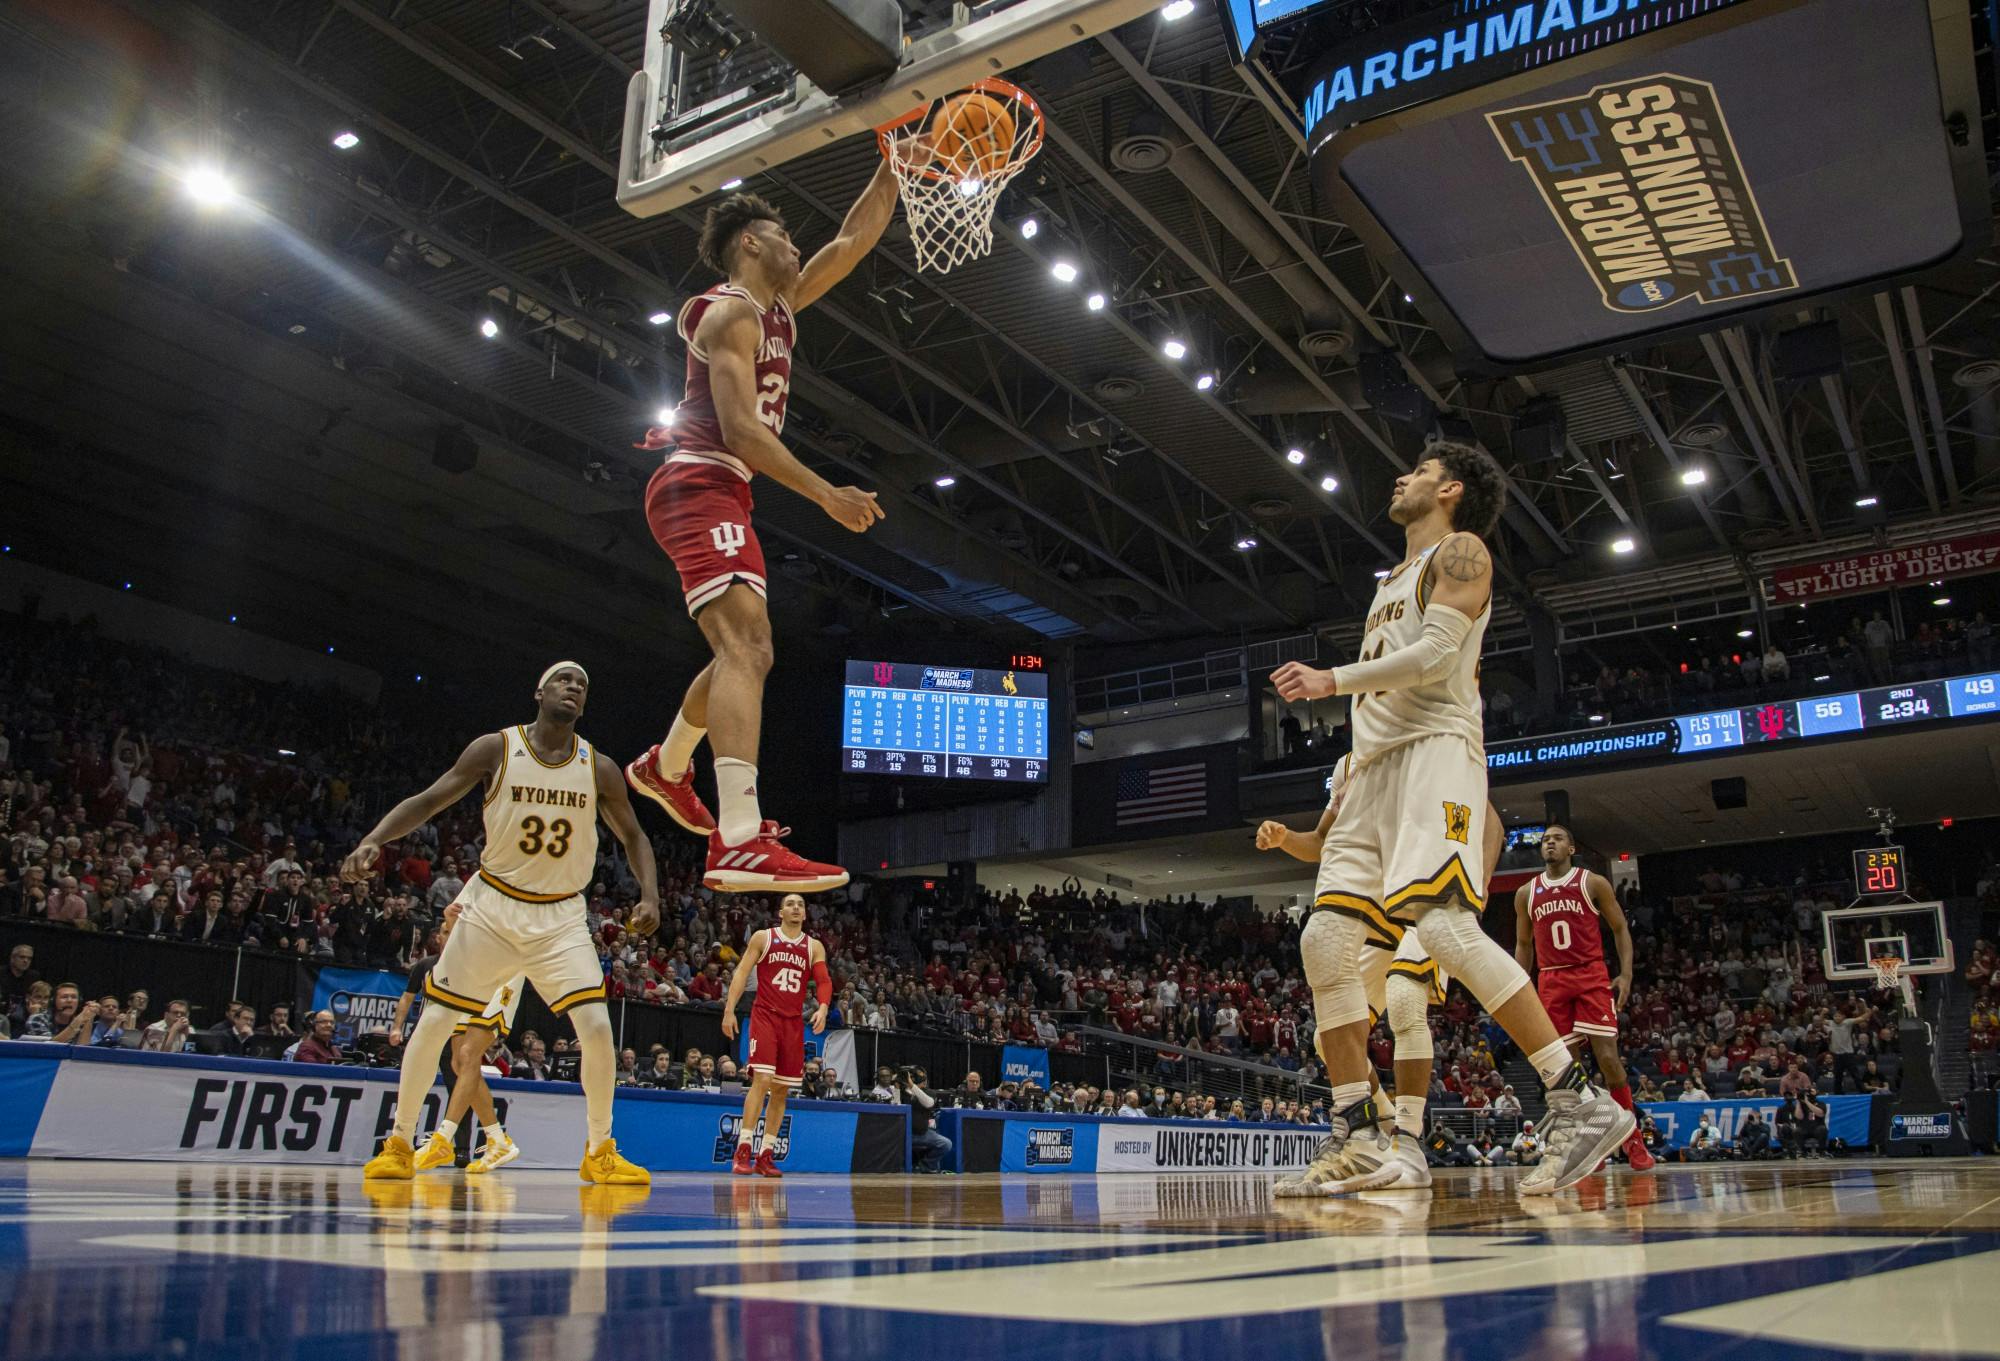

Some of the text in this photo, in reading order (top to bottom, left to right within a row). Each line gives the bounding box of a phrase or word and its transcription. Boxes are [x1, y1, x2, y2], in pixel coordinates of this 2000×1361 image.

[1304, 0, 1640, 141] MARCHMAD
[1599, 84, 1736, 256] MADNESS
[1554, 172, 1672, 283] MARCH
[1641, 280, 1664, 302] NCAA
[1821, 543, 1952, 574] THE CONNOR
[1795, 549, 1985, 596] FLIGHT DECK
[1012, 656, 1042, 668] 11:34
[933, 670, 960, 680] MARCH
[935, 679, 972, 688] MADNESS
[1889, 688, 1914, 699] 2ND
[1965, 678, 1994, 695] 49
[849, 689, 944, 703] PLYR PTS REB AST FLS
[952, 696, 969, 705] PLYR
[975, 698, 989, 706] PTS
[995, 699, 1008, 708] REB
[1015, 700, 1027, 708] AST
[1815, 702, 1842, 718] 56
[1880, 699, 1930, 720] 2:34
[1966, 702, 1996, 713] BONUS
[1690, 714, 1736, 732] FLS TOL
[1694, 731, 1732, 747] 10 1
[852, 750, 936, 763] FG% 3PT% FT%
[1488, 731, 1667, 768] TBALL CHAMPIONSHIP
[890, 763, 901, 771] 15
[924, 765, 936, 773] 53
[958, 757, 1040, 769] FG% 3PT% FT%
[511, 785, 587, 809] WYOMING
[519, 815, 573, 858] 33
[1867, 866, 1896, 890] 20
[1534, 900, 1584, 922] INDIANA
[1551, 920, 1572, 950] 0
[768, 951, 806, 970] INDIANA
[772, 968, 802, 993] 45
[350, 997, 396, 1020] MARC
[1005, 1063, 1044, 1078] NCAA.com
[179, 1078, 364, 1153] FIRST
[1902, 1116, 1934, 1126] MARCH
[1036, 1131, 1061, 1145] MARCH
[1907, 1125, 1949, 1134] MADNESS
[1039, 1145, 1072, 1159] MADNESS
[1114, 1141, 1141, 1154] HOSTED
[1142, 1141, 1152, 1154] BY
[1155, 1131, 1249, 1167] UNIVERSITY
[1252, 1134, 1270, 1166] OF
